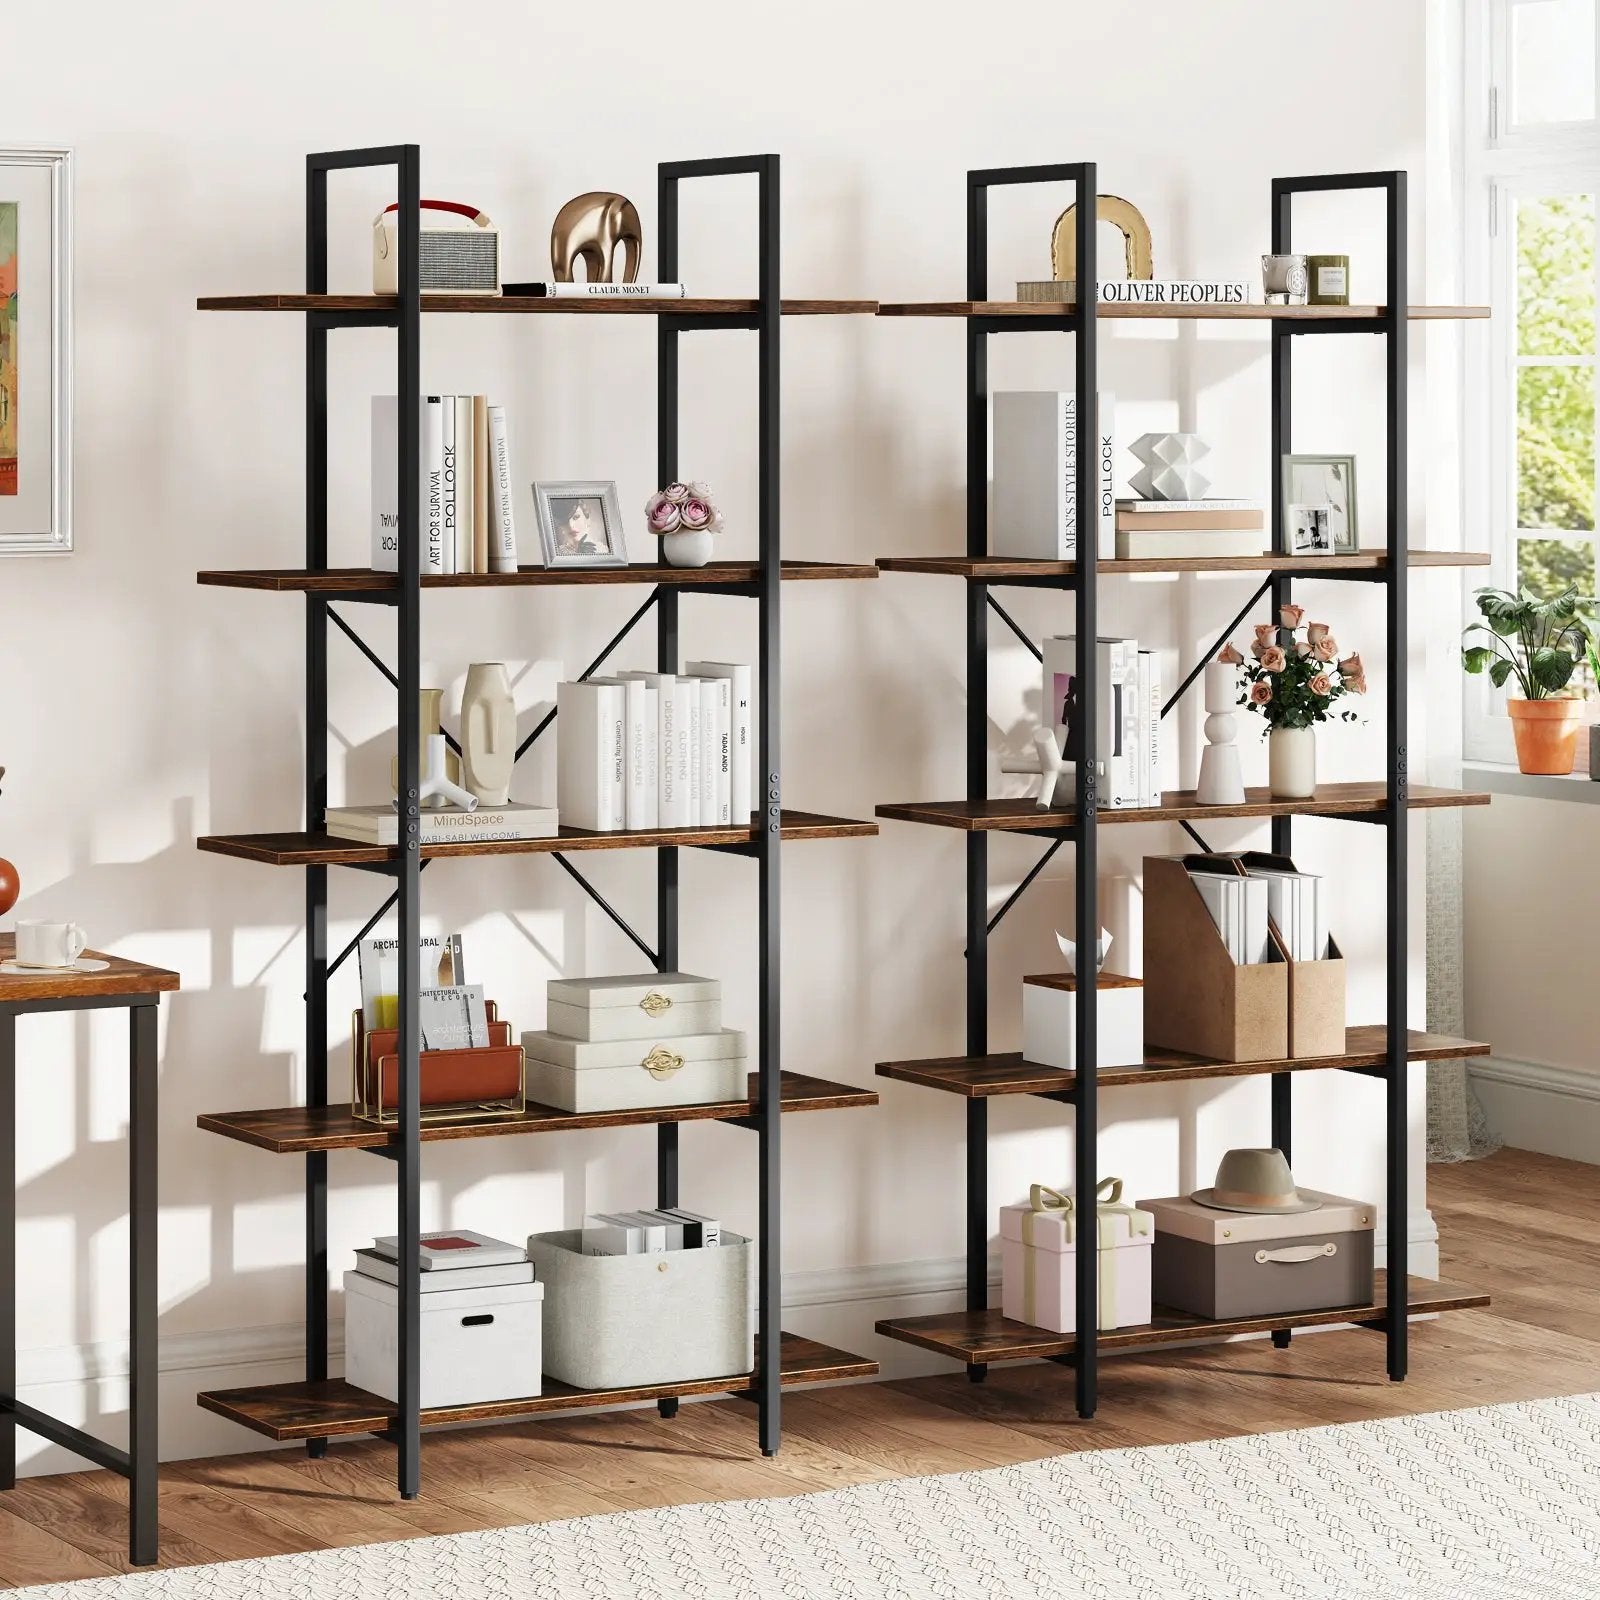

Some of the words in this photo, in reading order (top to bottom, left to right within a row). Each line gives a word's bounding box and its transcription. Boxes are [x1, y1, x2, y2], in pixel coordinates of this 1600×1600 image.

[588, 286, 620, 294] CLAUDE
[622, 286, 650, 294] MONET
[1102, 283, 1166, 302] OLIVER
[1171, 283, 1243, 303] PEOPLES
[1065, 399, 1076, 459] STORIES
[497, 437, 508, 490] CENTENNIAL
[1102, 435, 1112, 517] POLLOCK
[429, 470, 440, 518] SURVIVAL
[444, 445, 455, 528] POLLOCK
[1065, 461, 1076, 511] STYLE
[382, 536, 397, 551] FOR
[429, 521, 440, 542] FOR
[502, 518, 513, 551] IRVING
[1065, 514, 1076, 550] MEN'S
[429, 546, 440, 566] ART
[664, 701, 672, 738] DESIGN
[664, 740, 673, 803] COLLECTION
[679, 731, 687, 780] CLOTHING
[433, 814, 504, 827] MindSpace
[470, 831, 521, 840] WELCOME
[419, 989, 459, 998] CHITECTURAL
